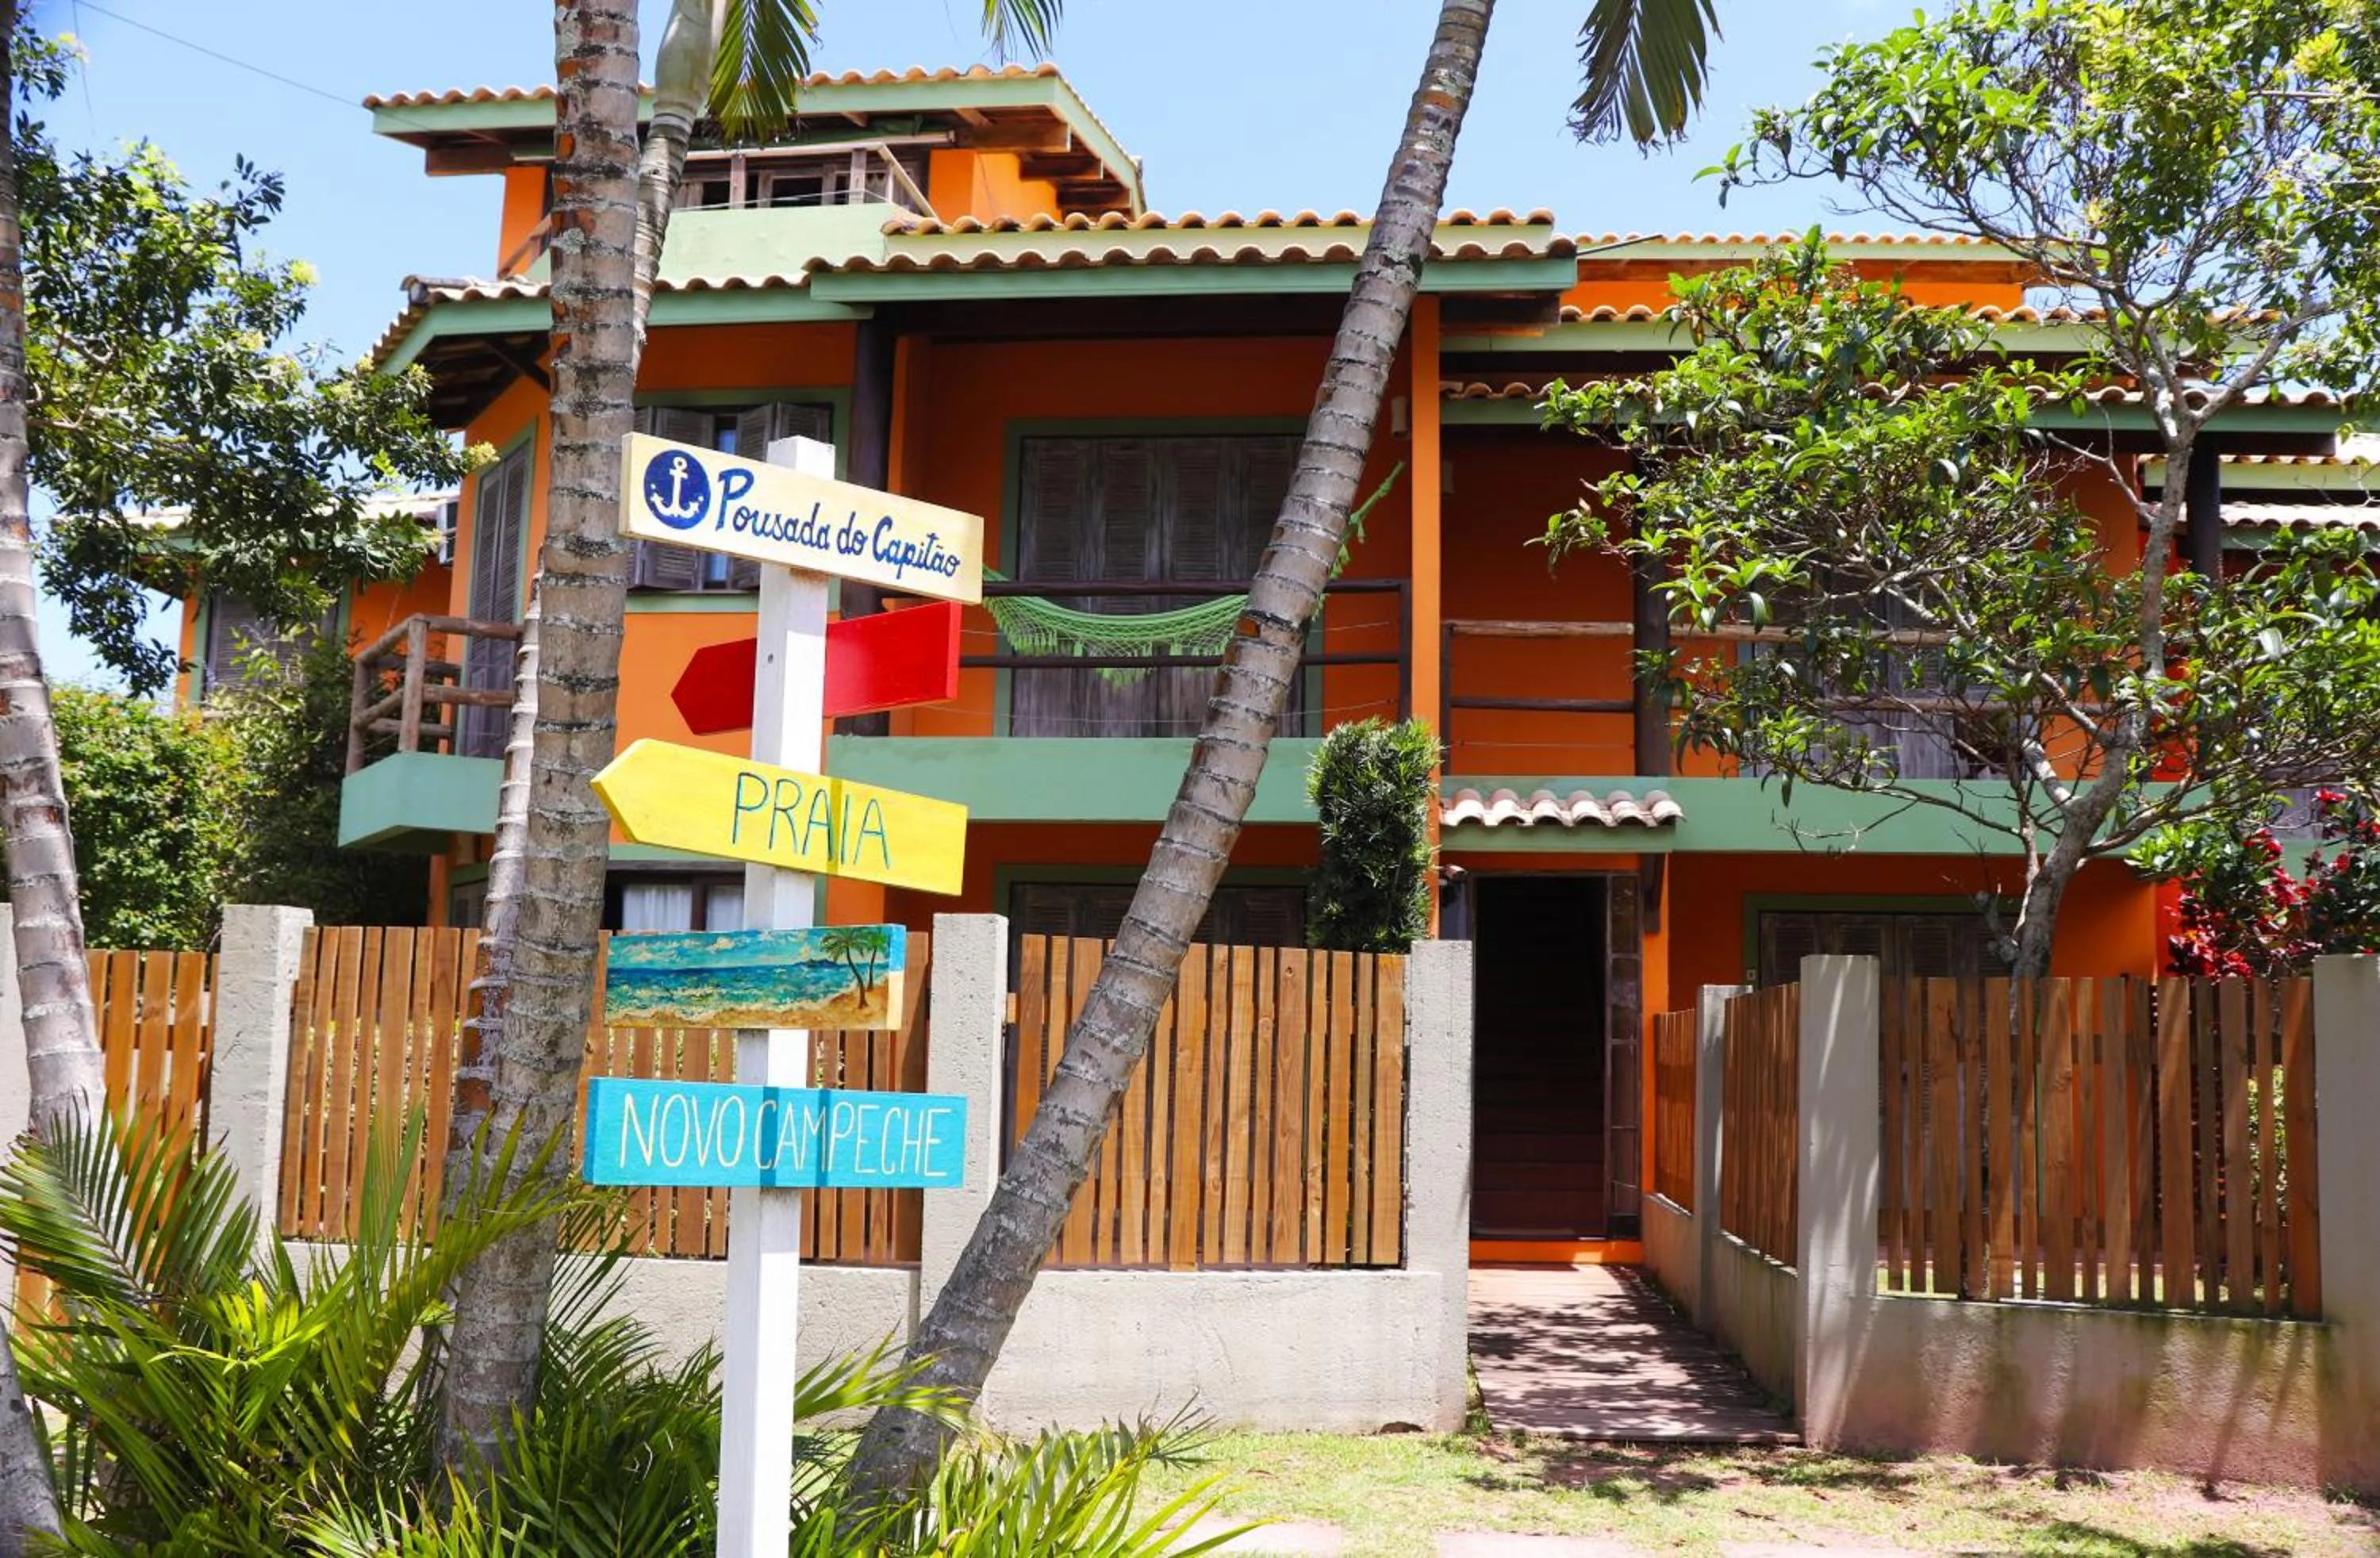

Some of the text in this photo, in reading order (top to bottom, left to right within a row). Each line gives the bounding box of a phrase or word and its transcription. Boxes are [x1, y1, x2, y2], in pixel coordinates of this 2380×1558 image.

[715, 468, 961, 580] Pousada do Capitão
[732, 772, 890, 870] PRAIA
[619, 1092, 951, 1177] NOVO CAMPECHE
